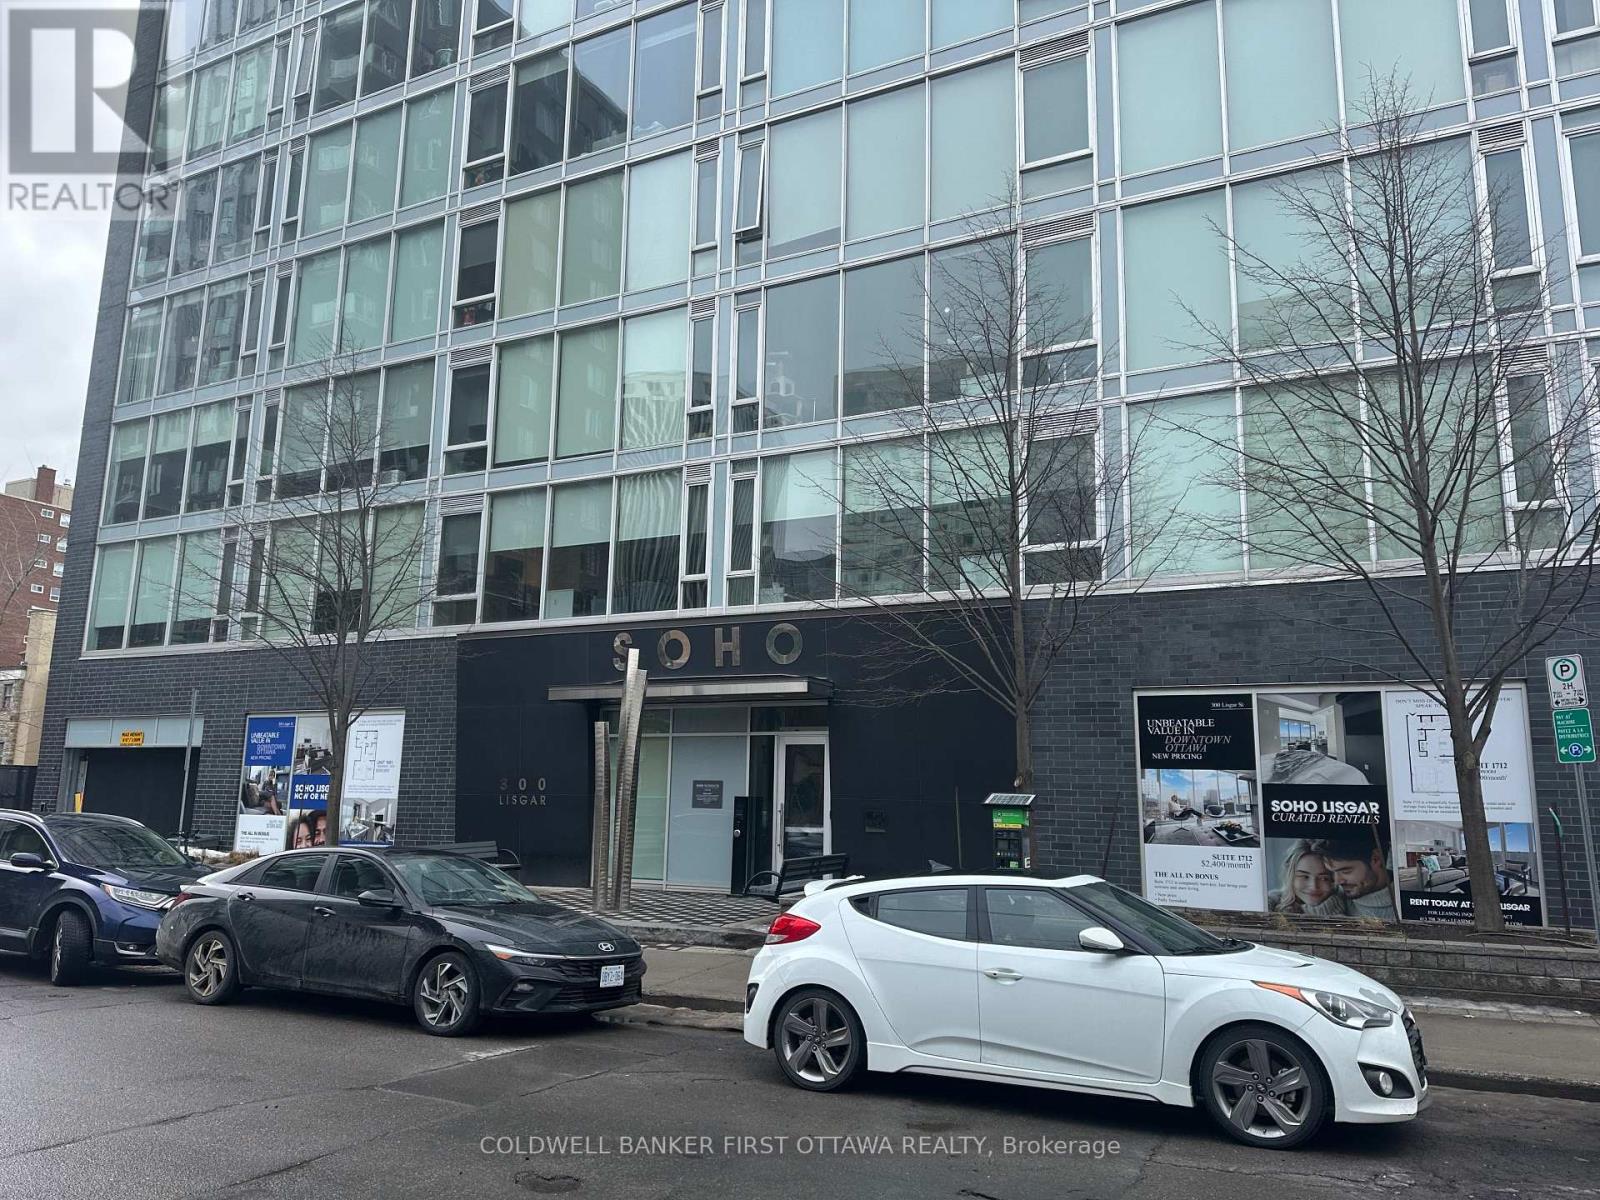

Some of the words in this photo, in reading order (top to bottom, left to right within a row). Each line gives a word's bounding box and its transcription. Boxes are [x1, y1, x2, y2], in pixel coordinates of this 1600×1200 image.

[612, 622, 803, 672] SOHO
[1146, 718, 1215, 728] UNBEATABLE
[1147, 727, 1181, 735] VALUE
[1183, 727, 1195, 735] IN
[1164, 735, 1232, 744] DOWNTOWN
[1165, 744, 1207, 753] OTTAWA
[316, 784, 330, 792] LISG
[499, 778, 546, 791] 300
[499, 795, 546, 806] LISGAR
[1271, 800, 1318, 813] SOHO
[1322, 801, 1380, 814] LISGAR
[1271, 812, 1326, 823] CURATED
[1328, 813, 1380, 825] RENTALS
[1409, 898, 1430, 906] RENT
[1431, 899, 1458, 908] TODAY
[1461, 900, 1471, 909] AT
